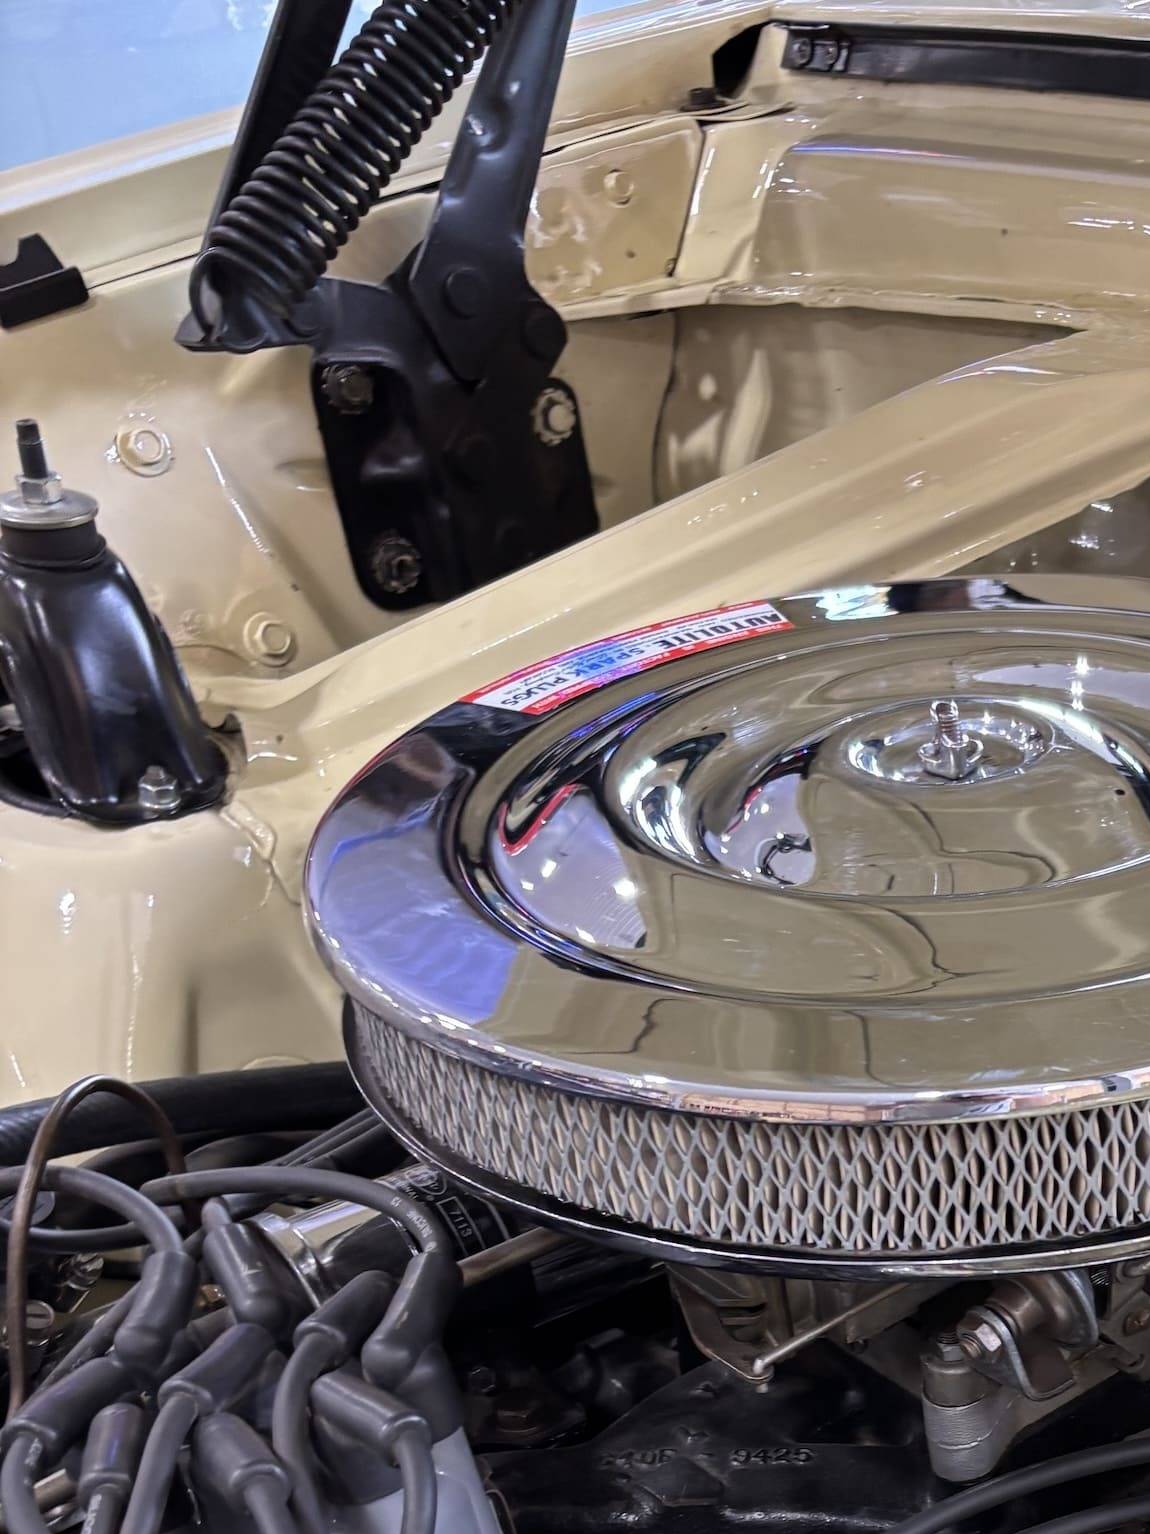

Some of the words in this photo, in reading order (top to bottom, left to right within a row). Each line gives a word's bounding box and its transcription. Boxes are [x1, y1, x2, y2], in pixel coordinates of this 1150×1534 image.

[652, 612, 782, 650] AUTOLITE
[567, 647, 646, 677] SPARK
[500, 675, 569, 706] PLUGS
[448, 1209, 474, 1238] 7113
[729, 1448, 815, 1467] 9425
